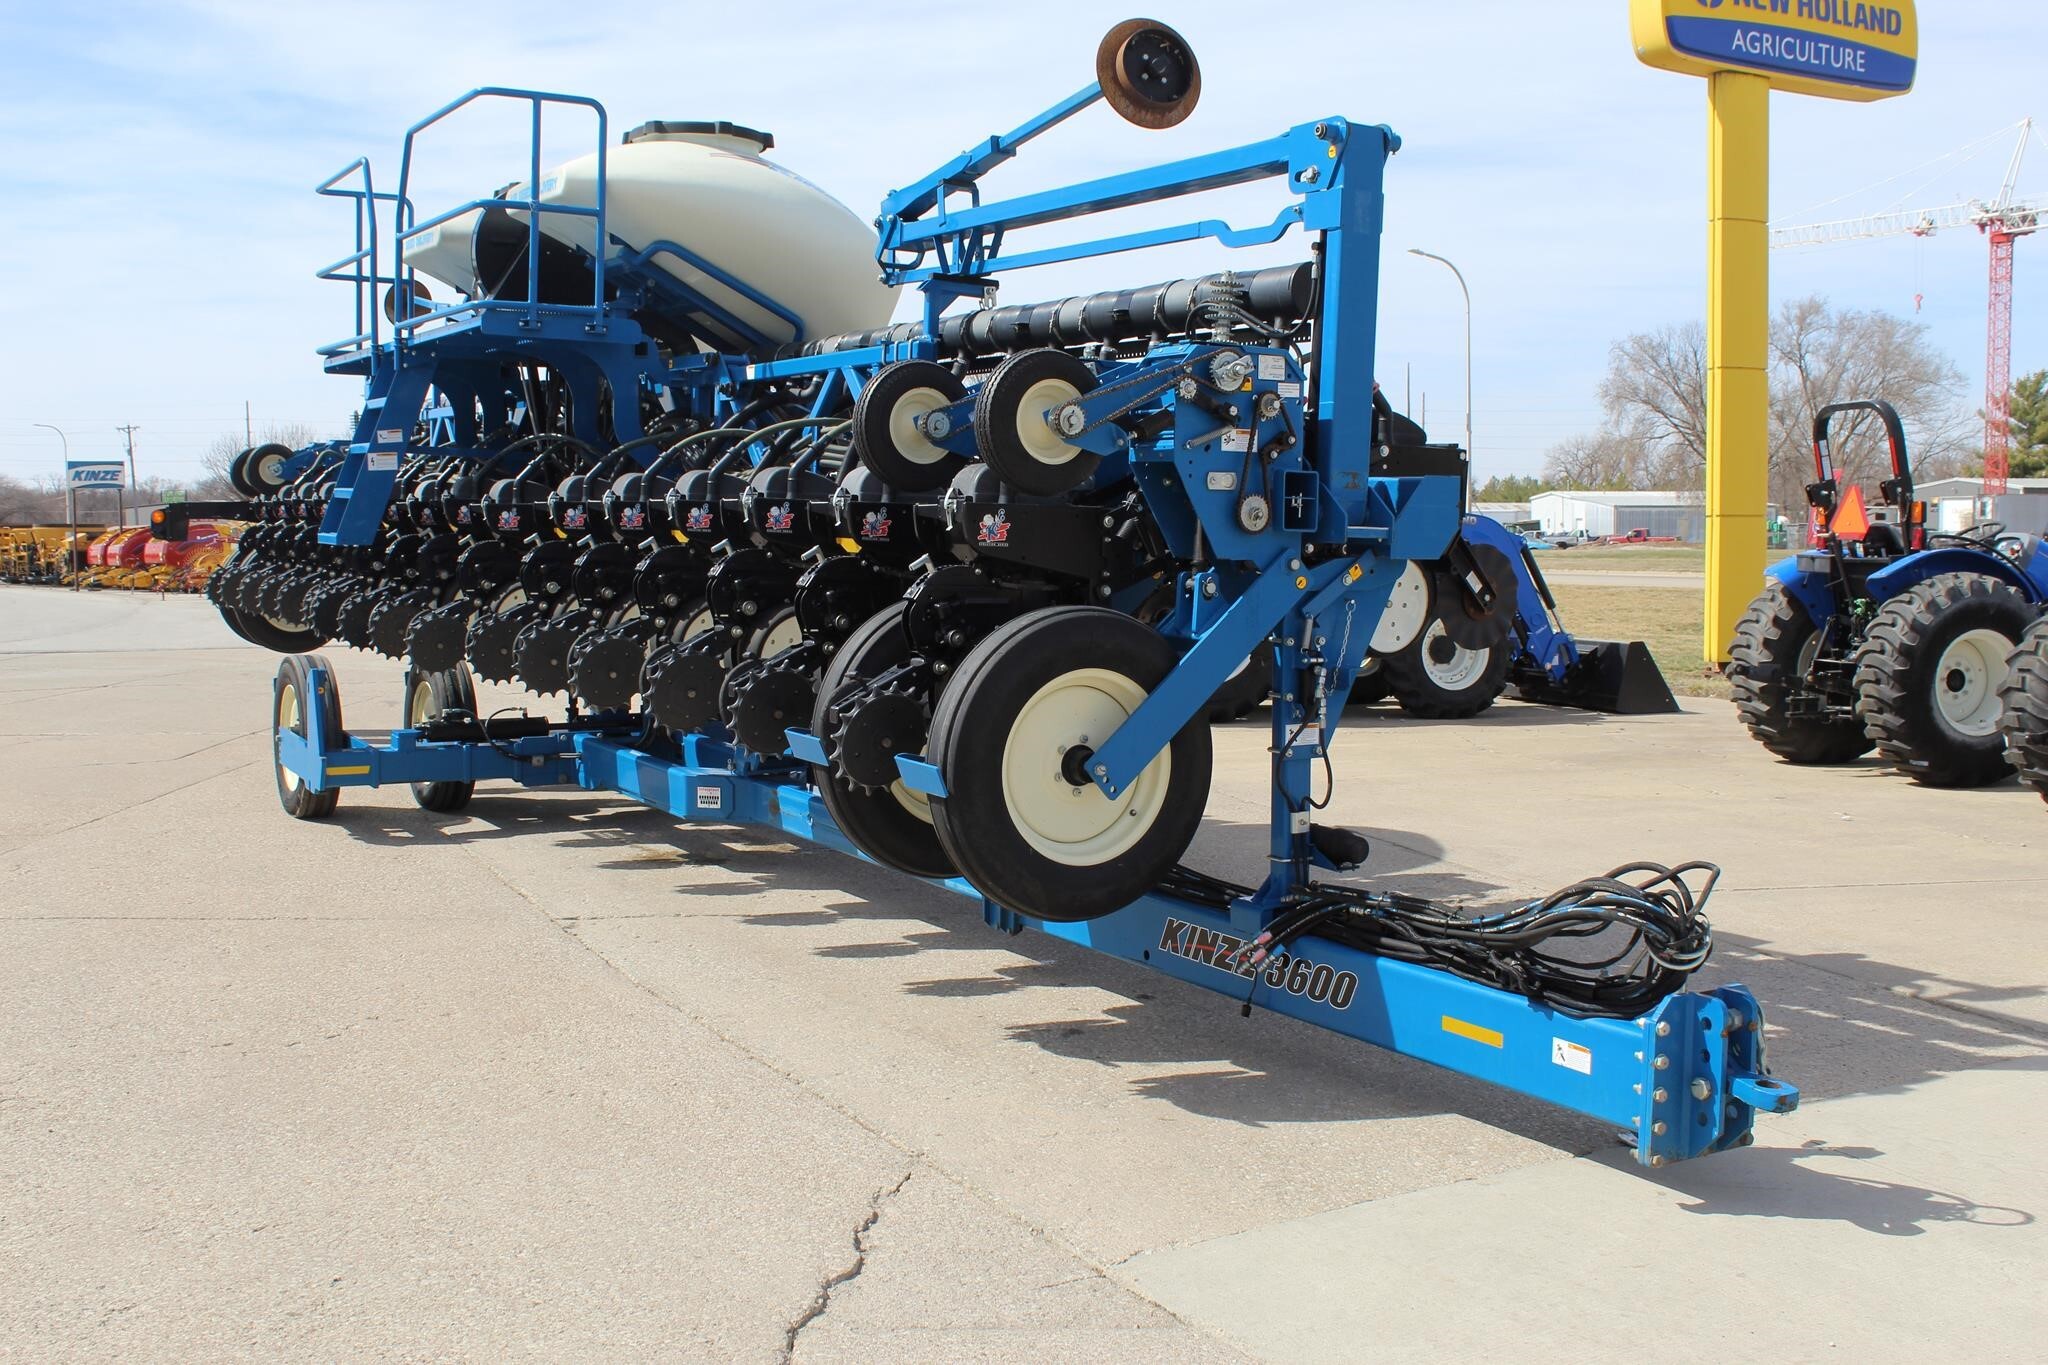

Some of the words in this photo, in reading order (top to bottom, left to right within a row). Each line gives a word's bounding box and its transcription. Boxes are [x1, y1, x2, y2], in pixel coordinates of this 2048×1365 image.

[1797, 0, 1901, 36] HOLLAND
[1732, 29, 1866, 72] AGRICULTURE
[72, 470, 121, 481] KINZE
[1264, 951, 1358, 1010] 3600
